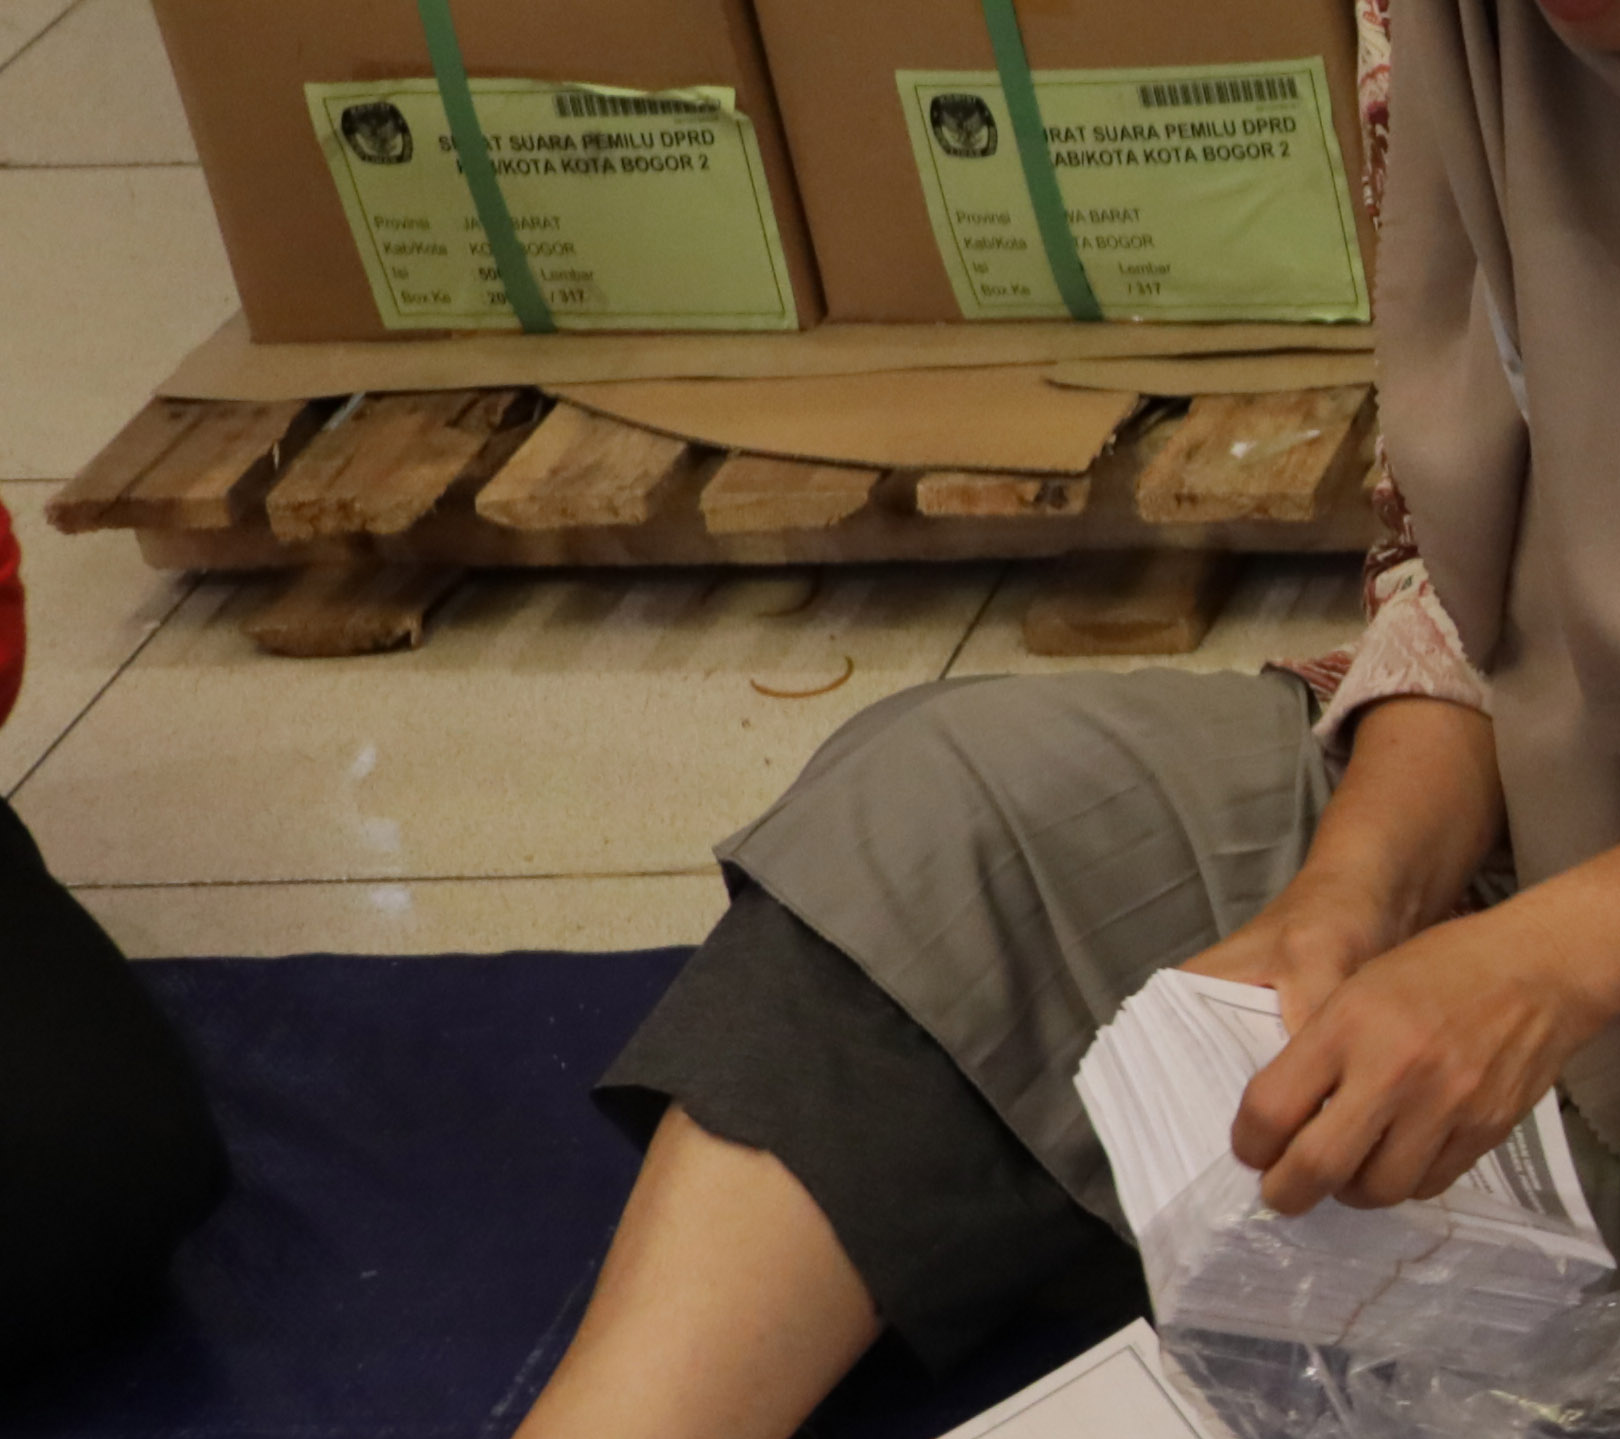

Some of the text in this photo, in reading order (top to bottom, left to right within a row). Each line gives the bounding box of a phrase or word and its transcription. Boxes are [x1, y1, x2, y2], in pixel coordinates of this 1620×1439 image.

[1093, 117, 1297, 141] SUARA PEMILU DPRD
[509, 130, 715, 152] SUARA PEMILU DPRD
[561, 154, 710, 174] KOTA BOGOR 2
[1054, 142, 1290, 168] AB/KOTA KOTA BOGOR 2
